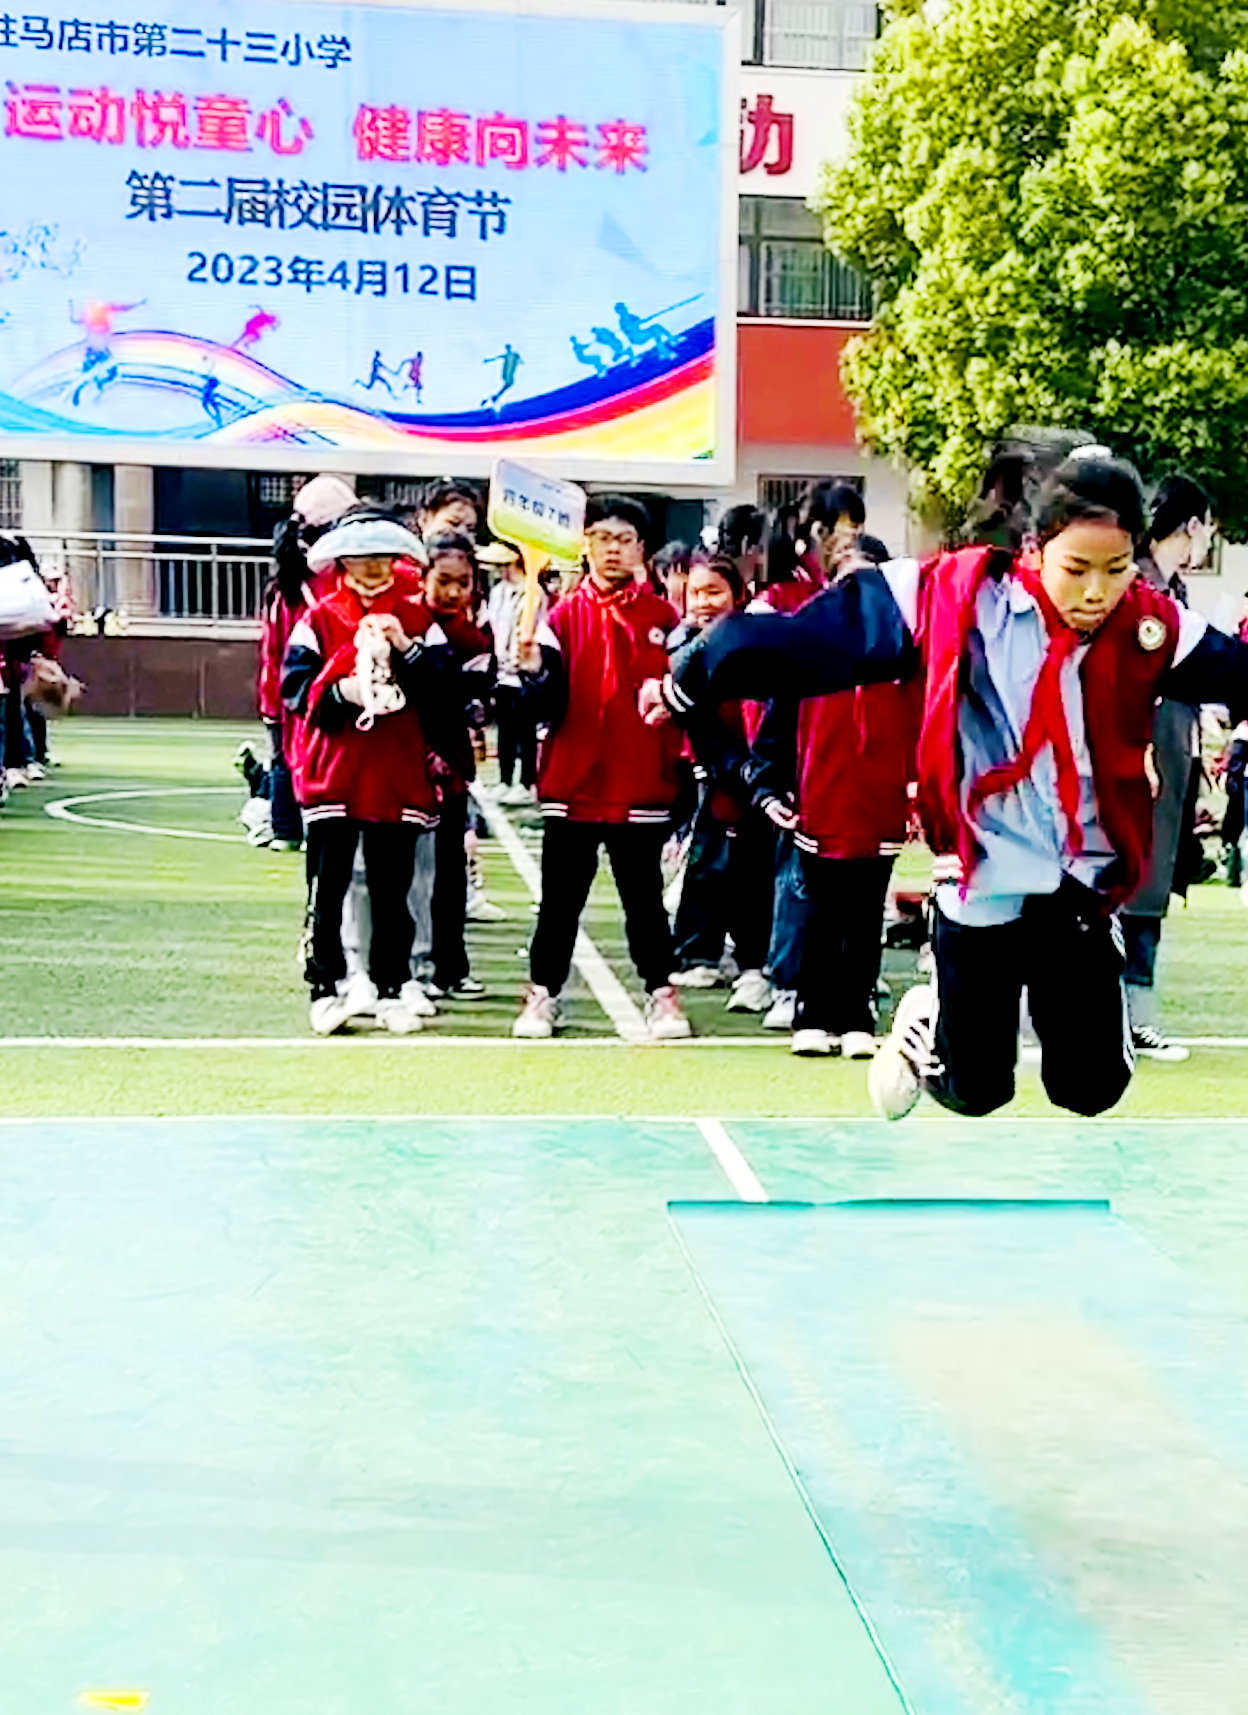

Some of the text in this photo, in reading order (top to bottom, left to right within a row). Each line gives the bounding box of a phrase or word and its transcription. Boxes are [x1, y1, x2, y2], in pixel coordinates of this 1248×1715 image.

[4, 82, 650, 174] 运动悦童心 健康向未来
[126, 170, 512, 241] 第二届校园体育节
[187, 251, 477, 301] 2023年4月12日
